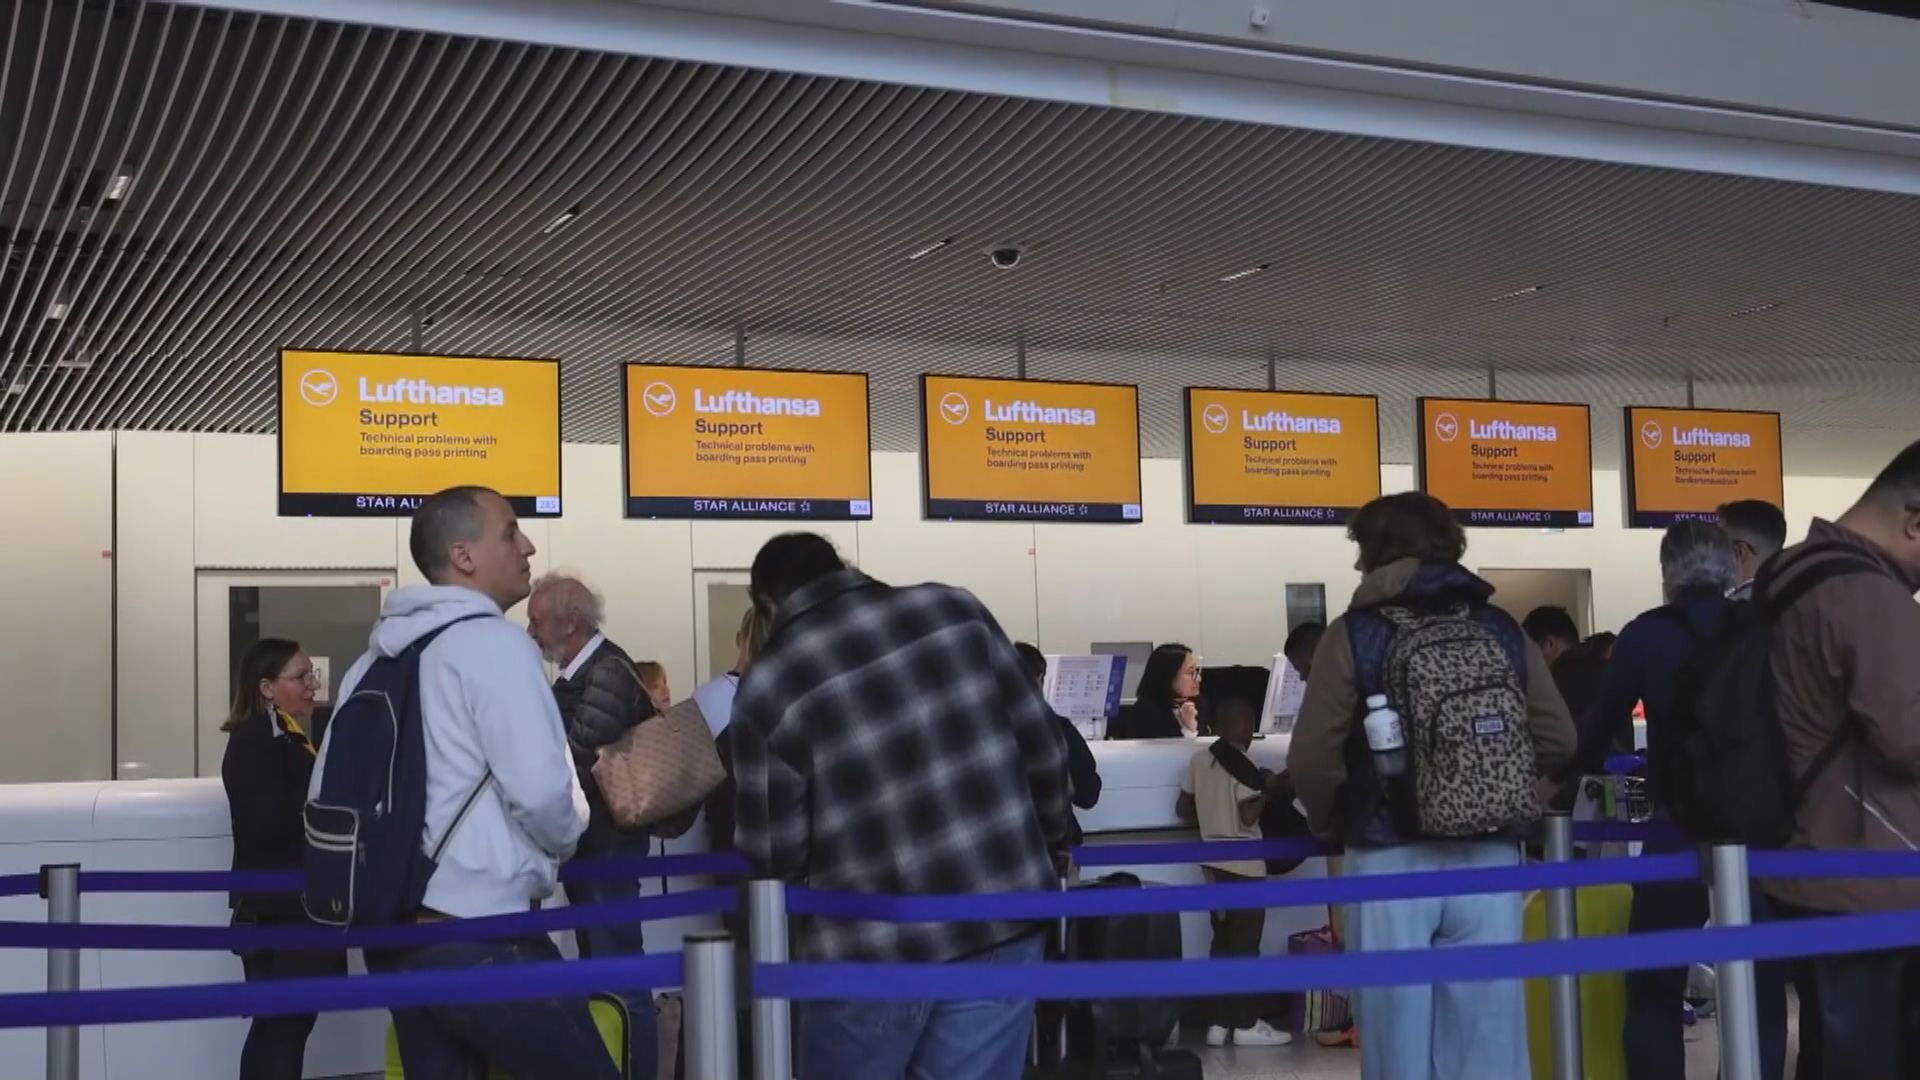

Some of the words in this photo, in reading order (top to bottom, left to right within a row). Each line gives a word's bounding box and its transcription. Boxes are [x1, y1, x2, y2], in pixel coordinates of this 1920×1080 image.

[359, 376, 504, 405] Lufthansa
[694, 388, 820, 416] Lufthansa
[360, 408, 438, 428] Support
[984, 399, 1096, 425] Lufthansa
[695, 418, 763, 437] Support
[1242, 410, 1340, 433] Lufthansa
[986, 428, 1045, 444] Support
[1470, 418, 1557, 441] Lufthansa
[1673, 426, 1751, 447] Lufthansa
[360, 432, 414, 444] Technical
[416, 433, 470, 447] problems
[472, 434, 497, 445] with
[1244, 436, 1296, 452] Support
[360, 446, 412, 458] boarding
[414, 449, 441, 459] pass
[443, 447, 487, 459] printing
[696, 440, 743, 451] Technical
[745, 442, 792, 454] problems
[794, 444, 815, 453] with
[987, 447, 1028, 457] Technical
[1030, 448, 1071, 460] problems
[1073, 451, 1092, 459] with
[1471, 444, 1517, 459] Support
[696, 452, 741, 464] boarding
[743, 456, 767, 464] pass
[769, 454, 807, 465] printing
[1244, 454, 1281, 464] Technical
[1282, 456, 1319, 467] problems
[1321, 458, 1337, 466] with
[1674, 450, 1716, 464] Support
[987, 459, 1026, 470] boarding
[1028, 462, 1049, 470] pass
[1050, 461, 1084, 471] printing
[1245, 466, 1280, 476] boarding
[1281, 468, 1300, 477] pass
[1301, 467, 1331, 478] printing
[356, 496, 395, 508] STAR
[694, 500, 727, 511] STAR
[731, 501, 795, 512] ALLIANCE
[985, 503, 1015, 514] STAR
[1019, 504, 1075, 515] ALLIANCE
[1244, 508, 1270, 517] STAR
[1273, 508, 1323, 518] ALLIANCE
[1471, 512, 1494, 521] STAR
[1497, 512, 1541, 521] ALLIANCE
